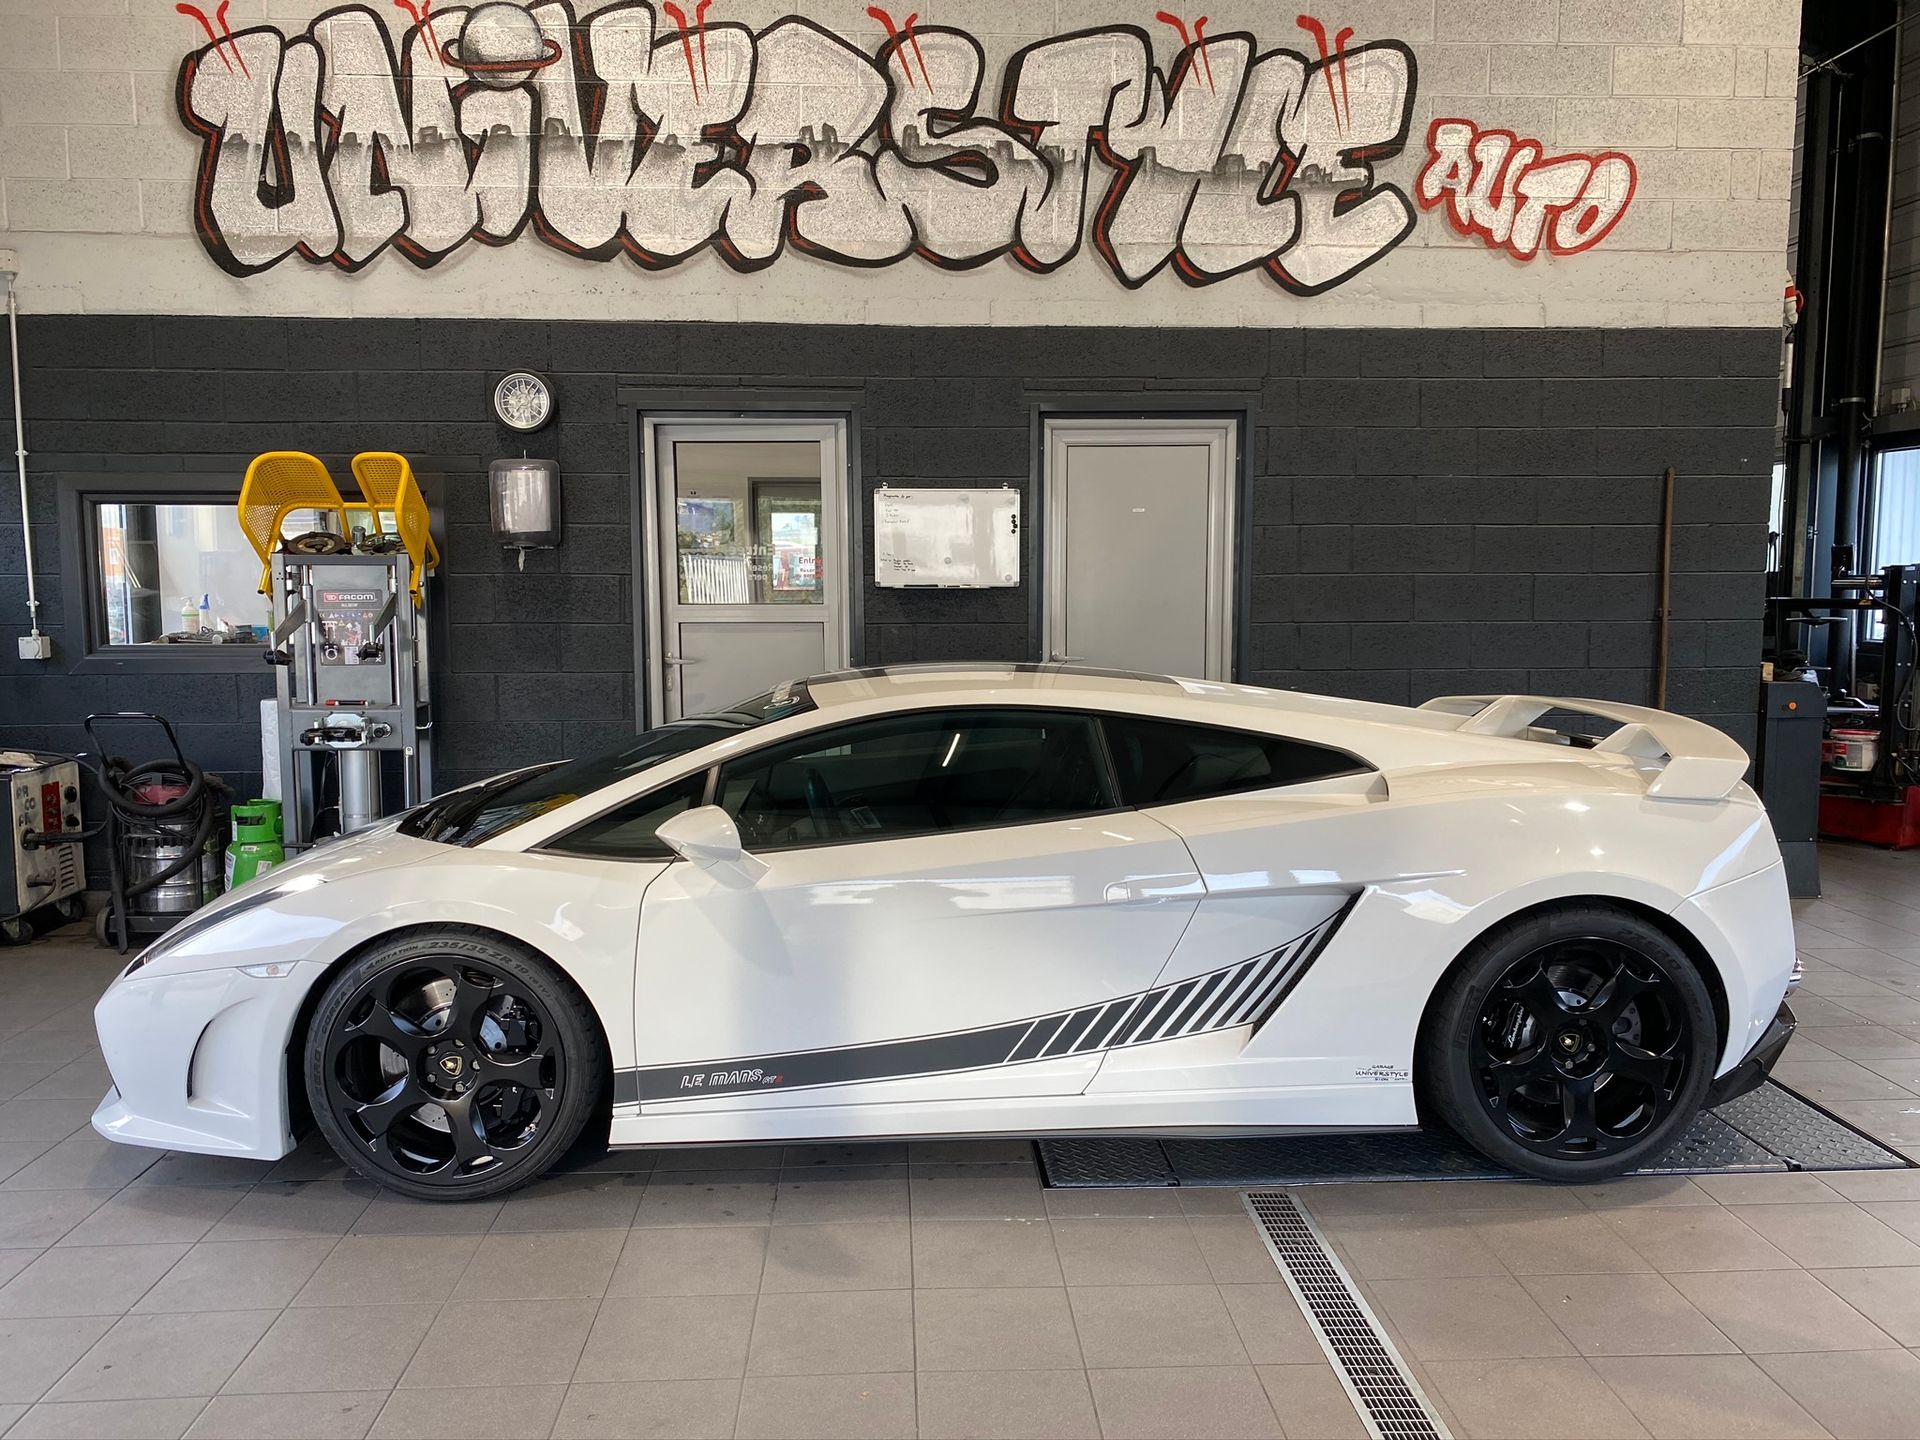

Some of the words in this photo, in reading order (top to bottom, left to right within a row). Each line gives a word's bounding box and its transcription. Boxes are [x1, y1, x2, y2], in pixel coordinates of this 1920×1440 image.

[1417, 118, 1638, 260] AUTO
[373, 944, 419, 967] ROTATION
[429, 941, 488, 955] 235/35
[487, 950, 513, 965] ZR
[514, 963, 529, 974] 19
[321, 990, 348, 1034] CORSA
[680, 1074, 705, 1089] LE
[709, 1068, 764, 1087] MANS
